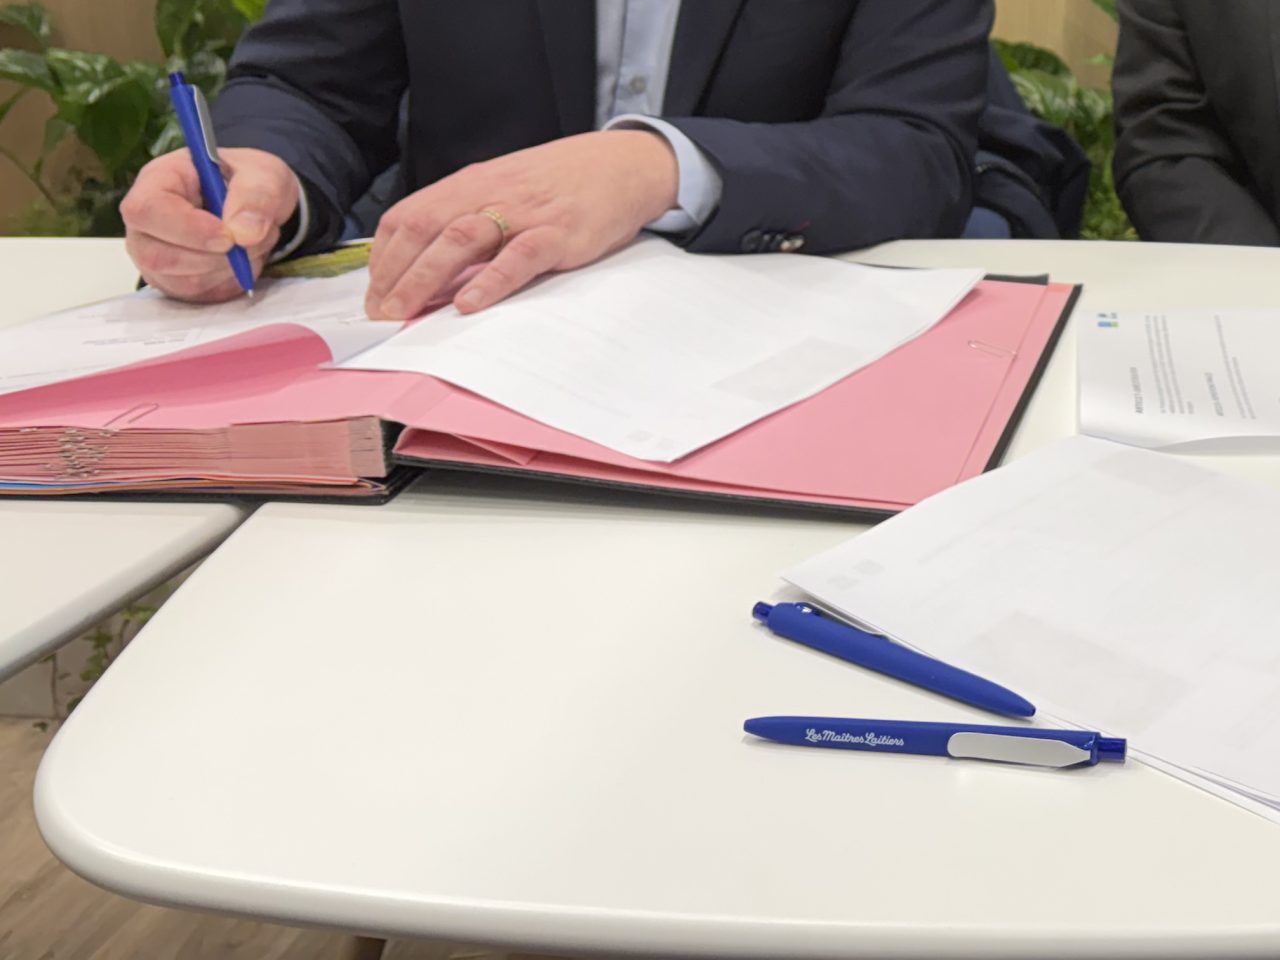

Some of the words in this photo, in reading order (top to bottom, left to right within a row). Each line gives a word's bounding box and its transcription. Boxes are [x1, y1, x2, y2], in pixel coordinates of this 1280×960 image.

[805, 728, 822, 743] Les
[821, 729, 865, 744] Maîtres
[864, 731, 905, 747] Laitiers
